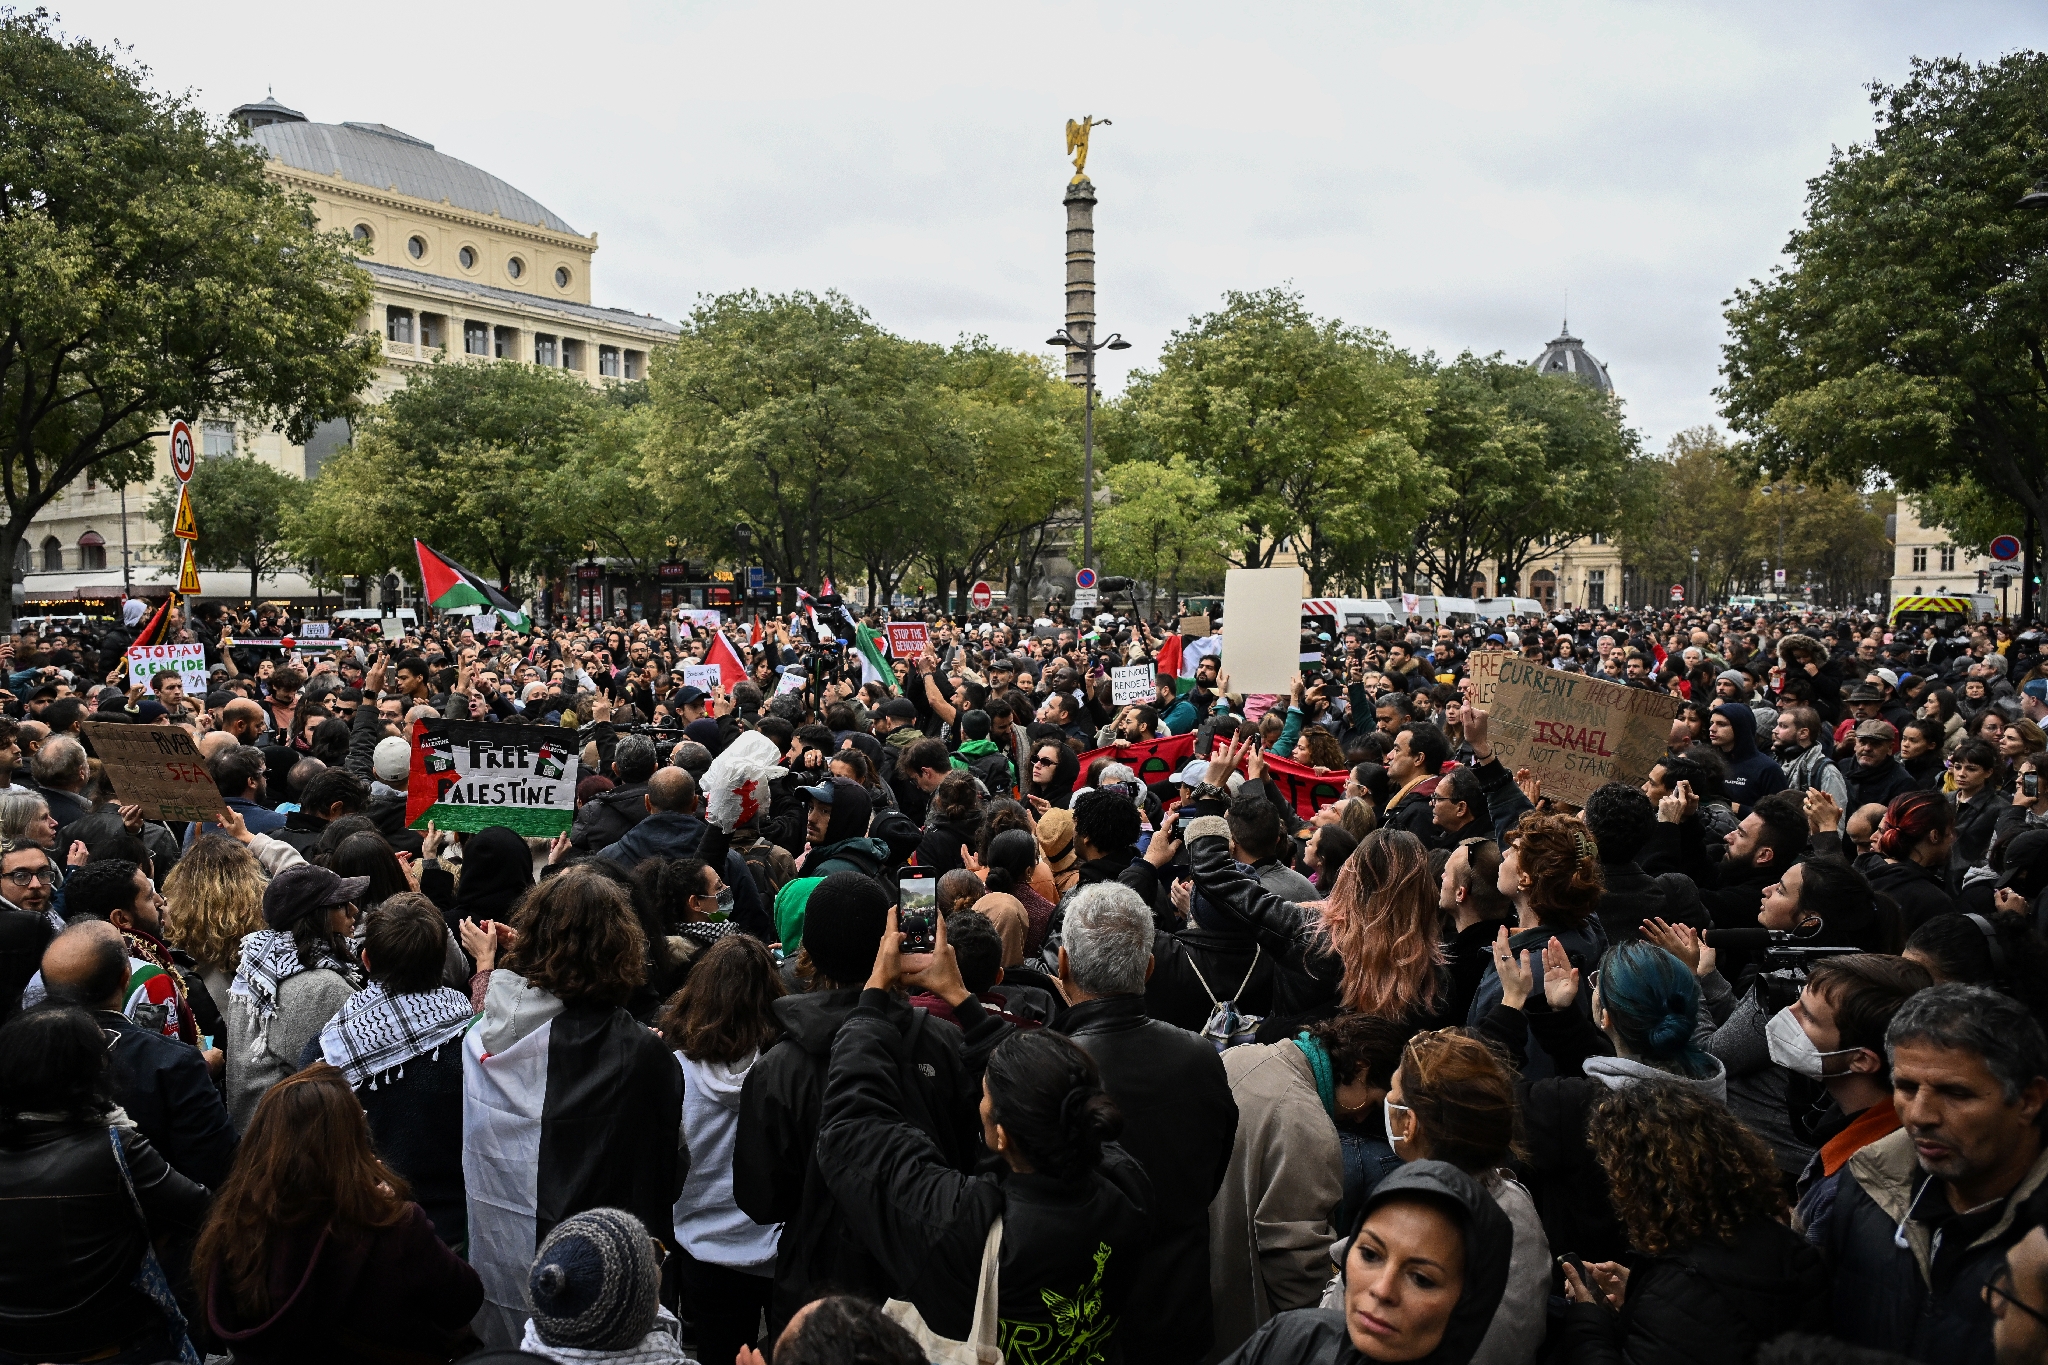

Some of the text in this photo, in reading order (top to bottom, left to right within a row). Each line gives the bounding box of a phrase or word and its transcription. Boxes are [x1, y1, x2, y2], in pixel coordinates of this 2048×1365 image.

[176, 438, 190, 465] 30
[893, 628, 924, 640] STOP THE
[129, 645, 177, 660] STOP
[895, 640, 925, 652] GENOCID
[1115, 670, 1126, 678] NE
[1115, 678, 1148, 690] RENDEZ
[1499, 661, 1579, 698] CURRENT
[151, 731, 199, 756] RIVER
[1532, 720, 1611, 757] ISRAEL
[467, 740, 529, 769] FREE
[1493, 741, 1515, 756] DO
[1528, 746, 1560, 764] NOT
[1564, 753, 1616, 779] STAND
[166, 762, 213, 785] SEA
[159, 804, 209, 821] FREE
